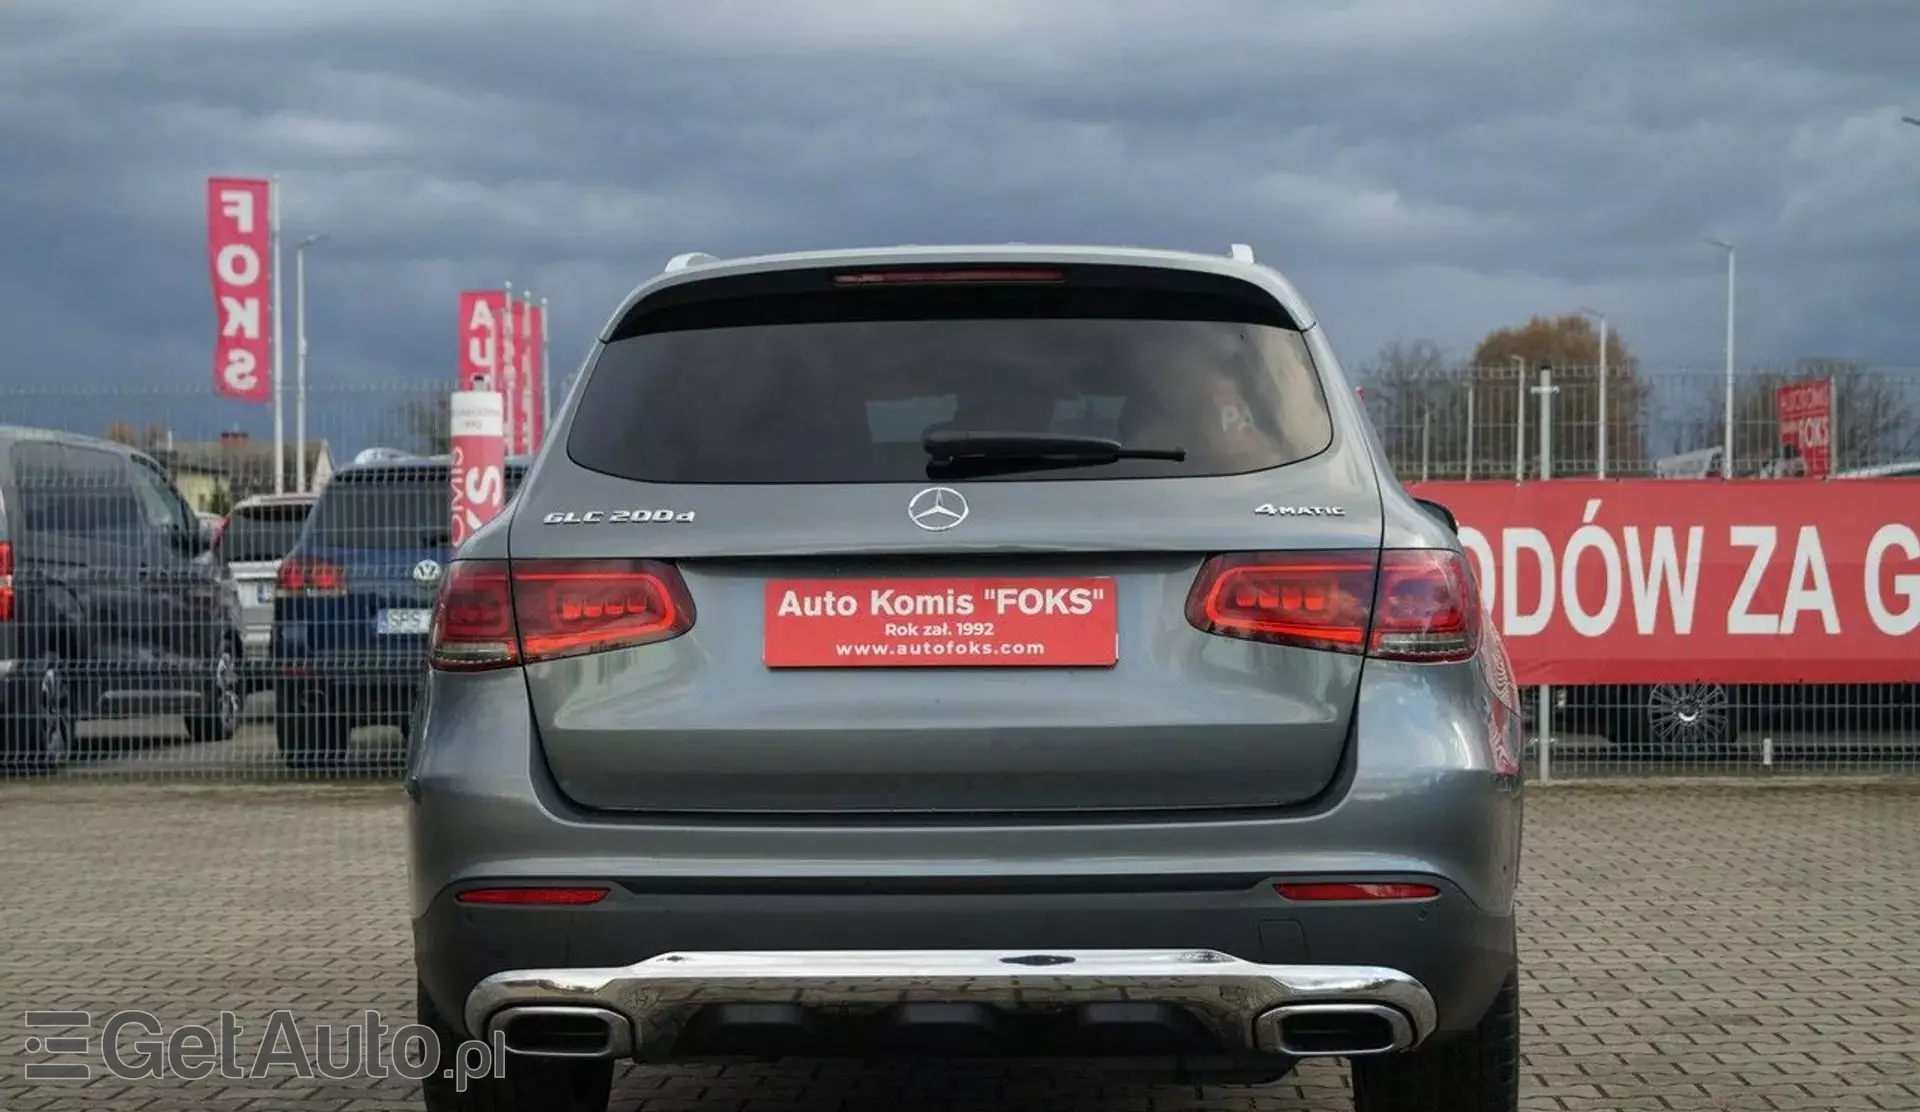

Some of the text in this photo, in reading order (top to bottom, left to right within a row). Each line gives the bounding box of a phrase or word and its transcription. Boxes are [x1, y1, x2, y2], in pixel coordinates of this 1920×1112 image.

[543, 509, 696, 525] GLC 200d
[1727, 525, 1842, 635] ZA
[777, 588, 1104, 617] Auto Komis "FOKS"
[884, 622, 995, 636] Rok zał. 1992
[835, 641, 1045, 656] www.autofoks.com
